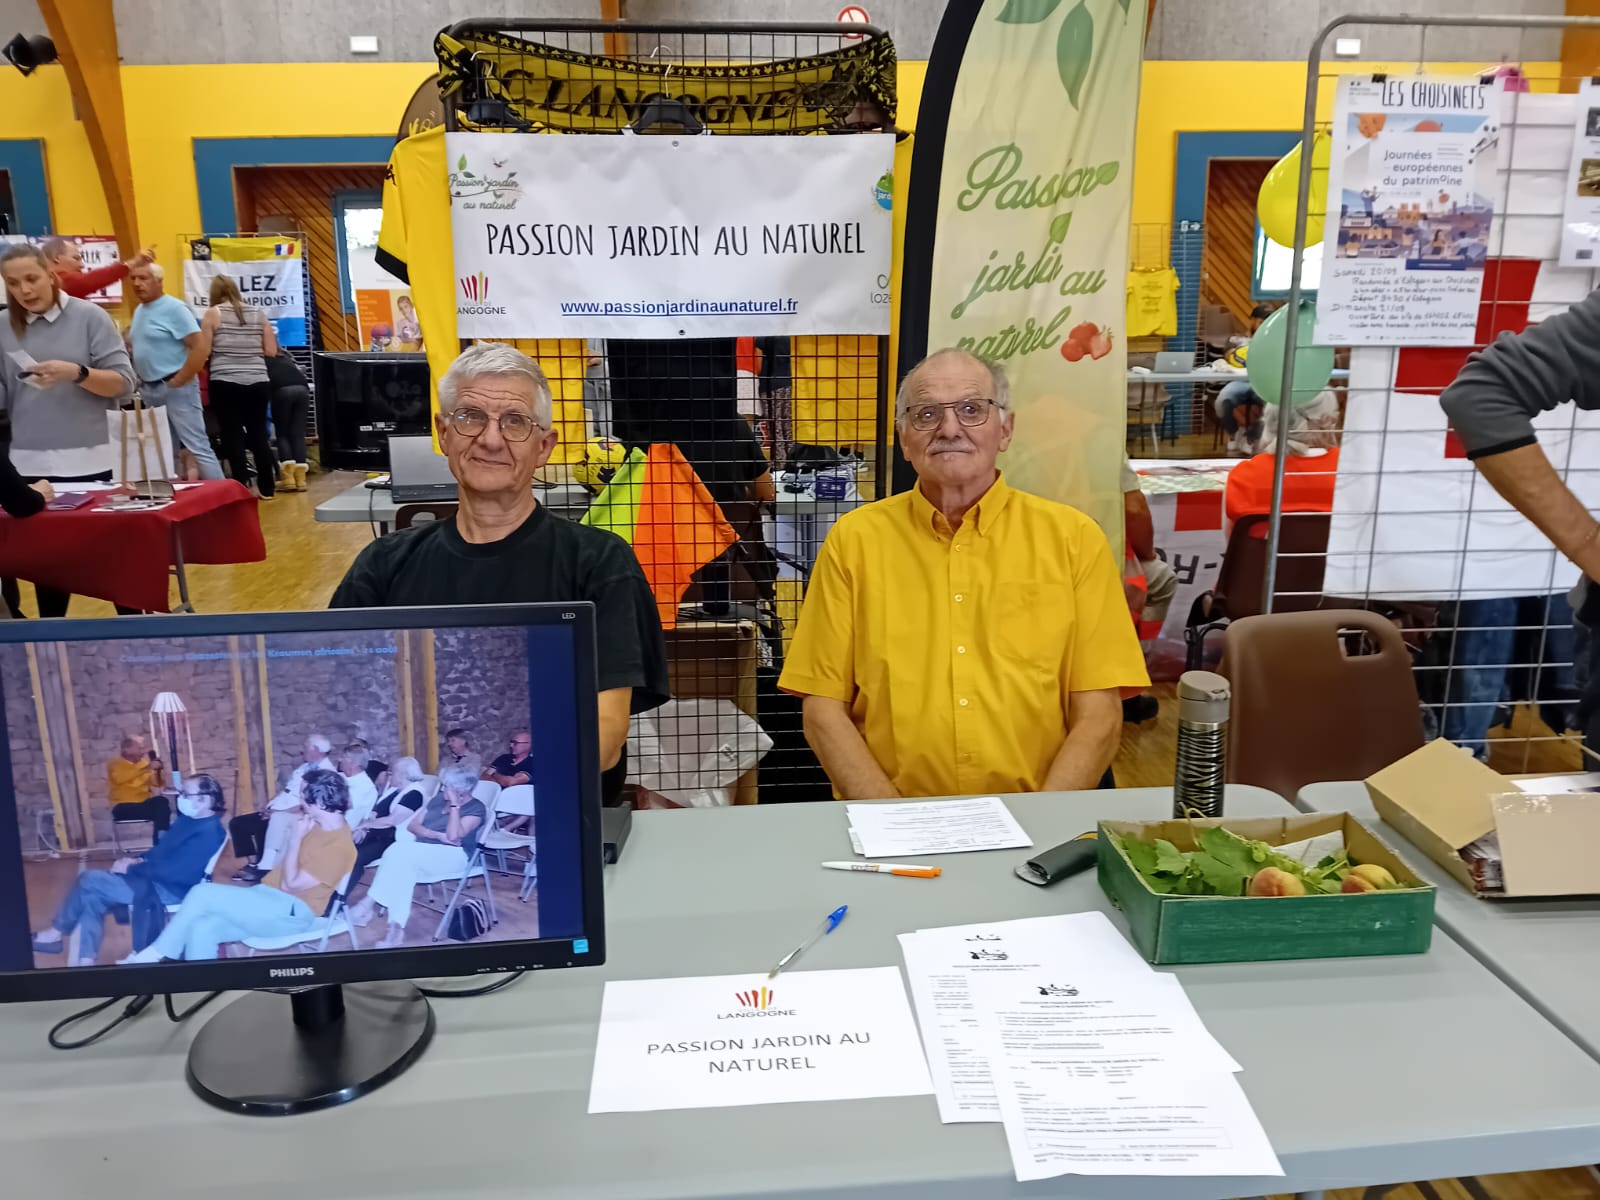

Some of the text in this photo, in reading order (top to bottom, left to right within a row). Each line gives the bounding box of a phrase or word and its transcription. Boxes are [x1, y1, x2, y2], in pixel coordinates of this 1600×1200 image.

[1382, 81, 1405, 107] LES
[1411, 81, 1486, 109] CHOISINETS
[1384, 150, 1432, 161] Journées
[1393, 162, 1463, 174] européennes
[1383, 175, 1462, 187] du patrimoine
[480, 198, 518, 210] naturel
[486, 222, 865, 259] PASSION JARDIN AU NATUREL
[1059, 269, 1107, 296] au
[194, 296, 209, 306] LE
[560, 298, 798, 316] www.passionjardinaunaturel.fr
[456, 306, 507, 315] ANGOGNE
[562, 612, 576, 620] LED
[270, 967, 314, 978] PHILIPS
[717, 1009, 798, 1020] LANGOGNE
[647, 1032, 871, 1054] PASSION JARDIN AU
[709, 1056, 816, 1073] NATUREL
